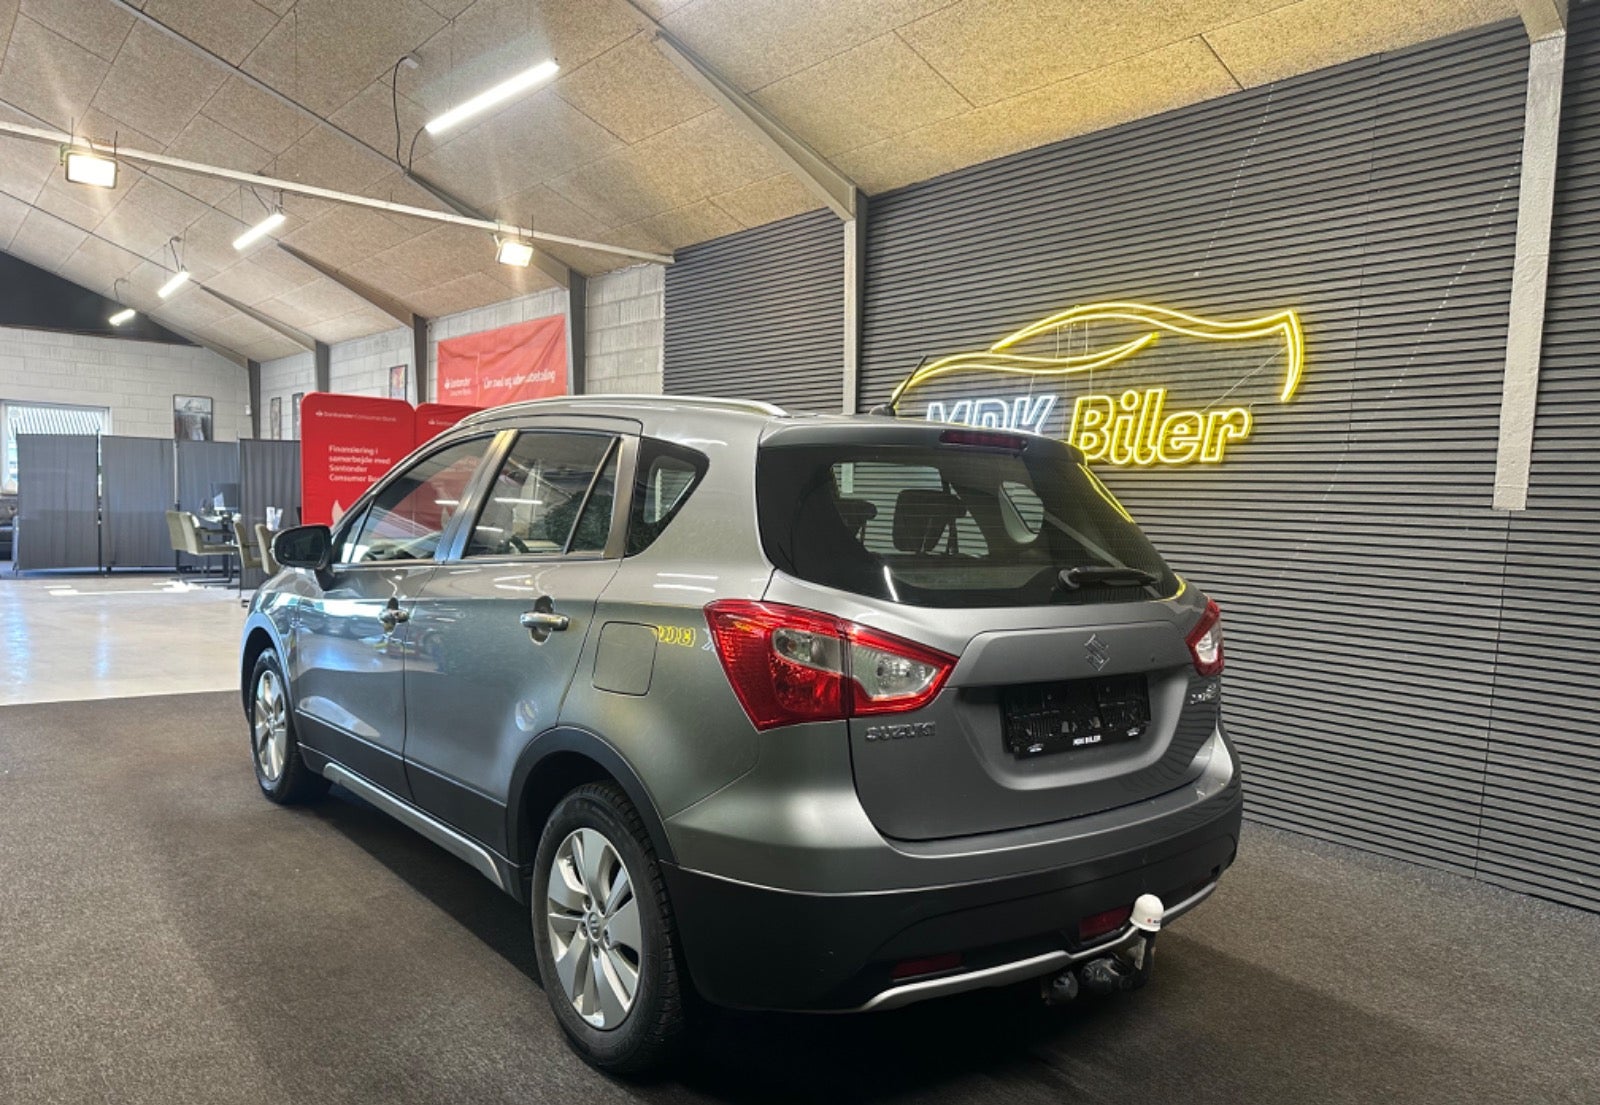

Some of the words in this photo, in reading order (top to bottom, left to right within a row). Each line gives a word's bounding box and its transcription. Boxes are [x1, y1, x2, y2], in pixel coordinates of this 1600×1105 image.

[1068, 388, 1253, 465] Biler
[328, 444, 374, 456] Finansiering
[328, 455, 373, 465] samarbejde
[374, 457, 391, 465] med
[328, 463, 368, 473] Santander
[328, 473, 367, 482] Consumer
[866, 721, 936, 741] SUZUKI
